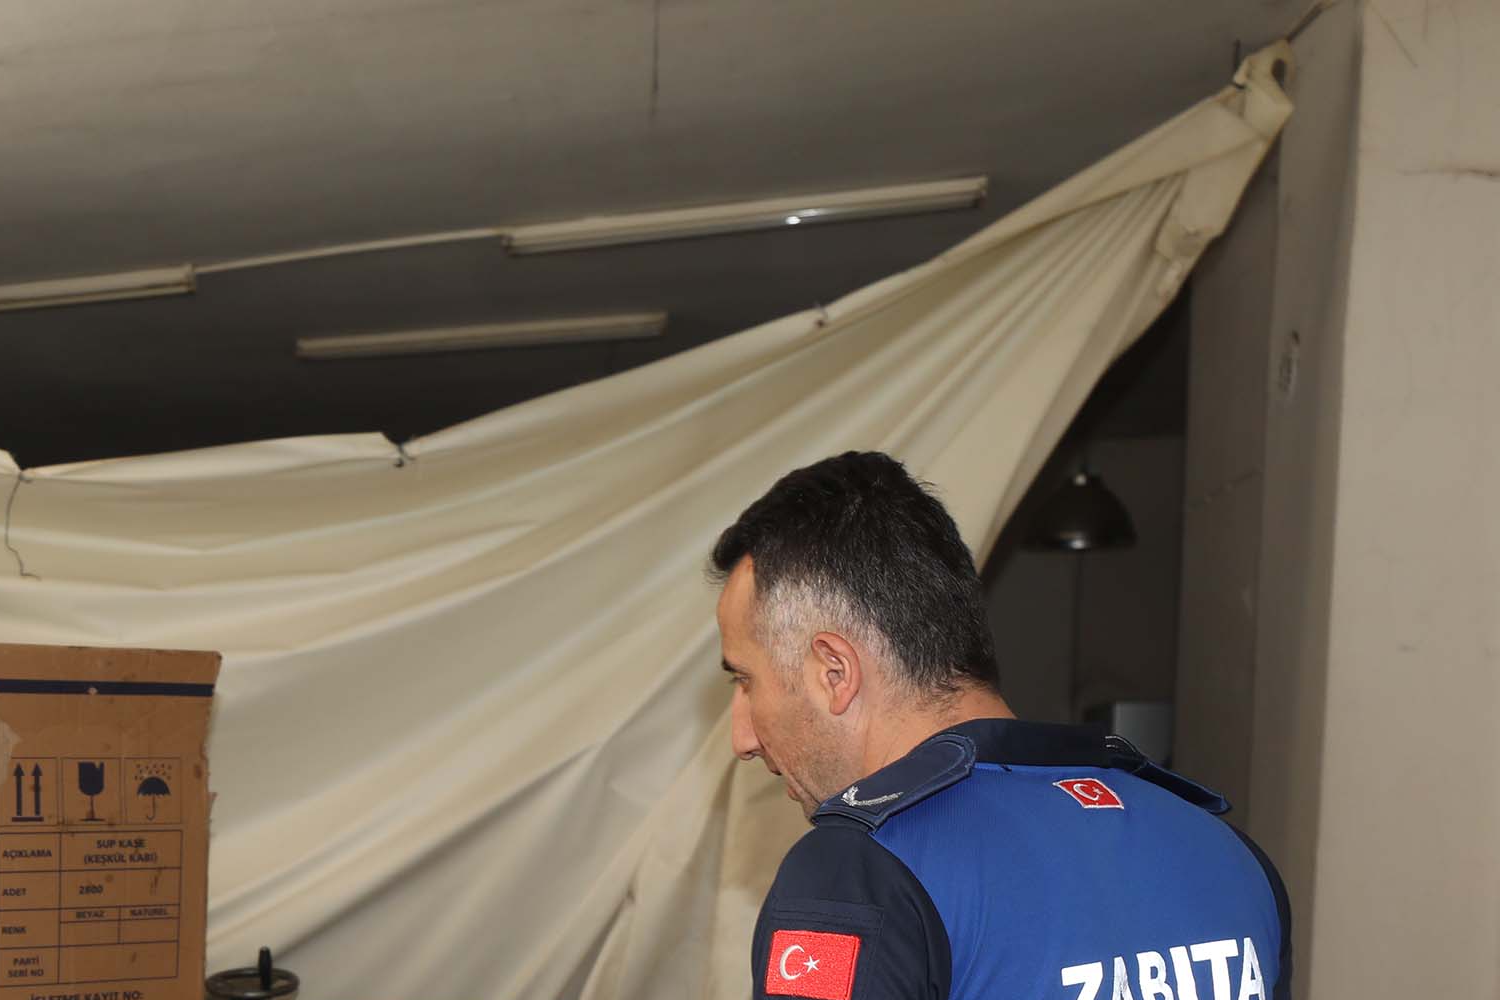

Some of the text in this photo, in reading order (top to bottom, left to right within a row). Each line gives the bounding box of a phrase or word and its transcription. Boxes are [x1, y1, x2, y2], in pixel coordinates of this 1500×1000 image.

[1, 848, 52, 862] AÇIKLAMA
[1, 887, 27, 898] ADET
[12, 954, 40, 967] PARTİ
